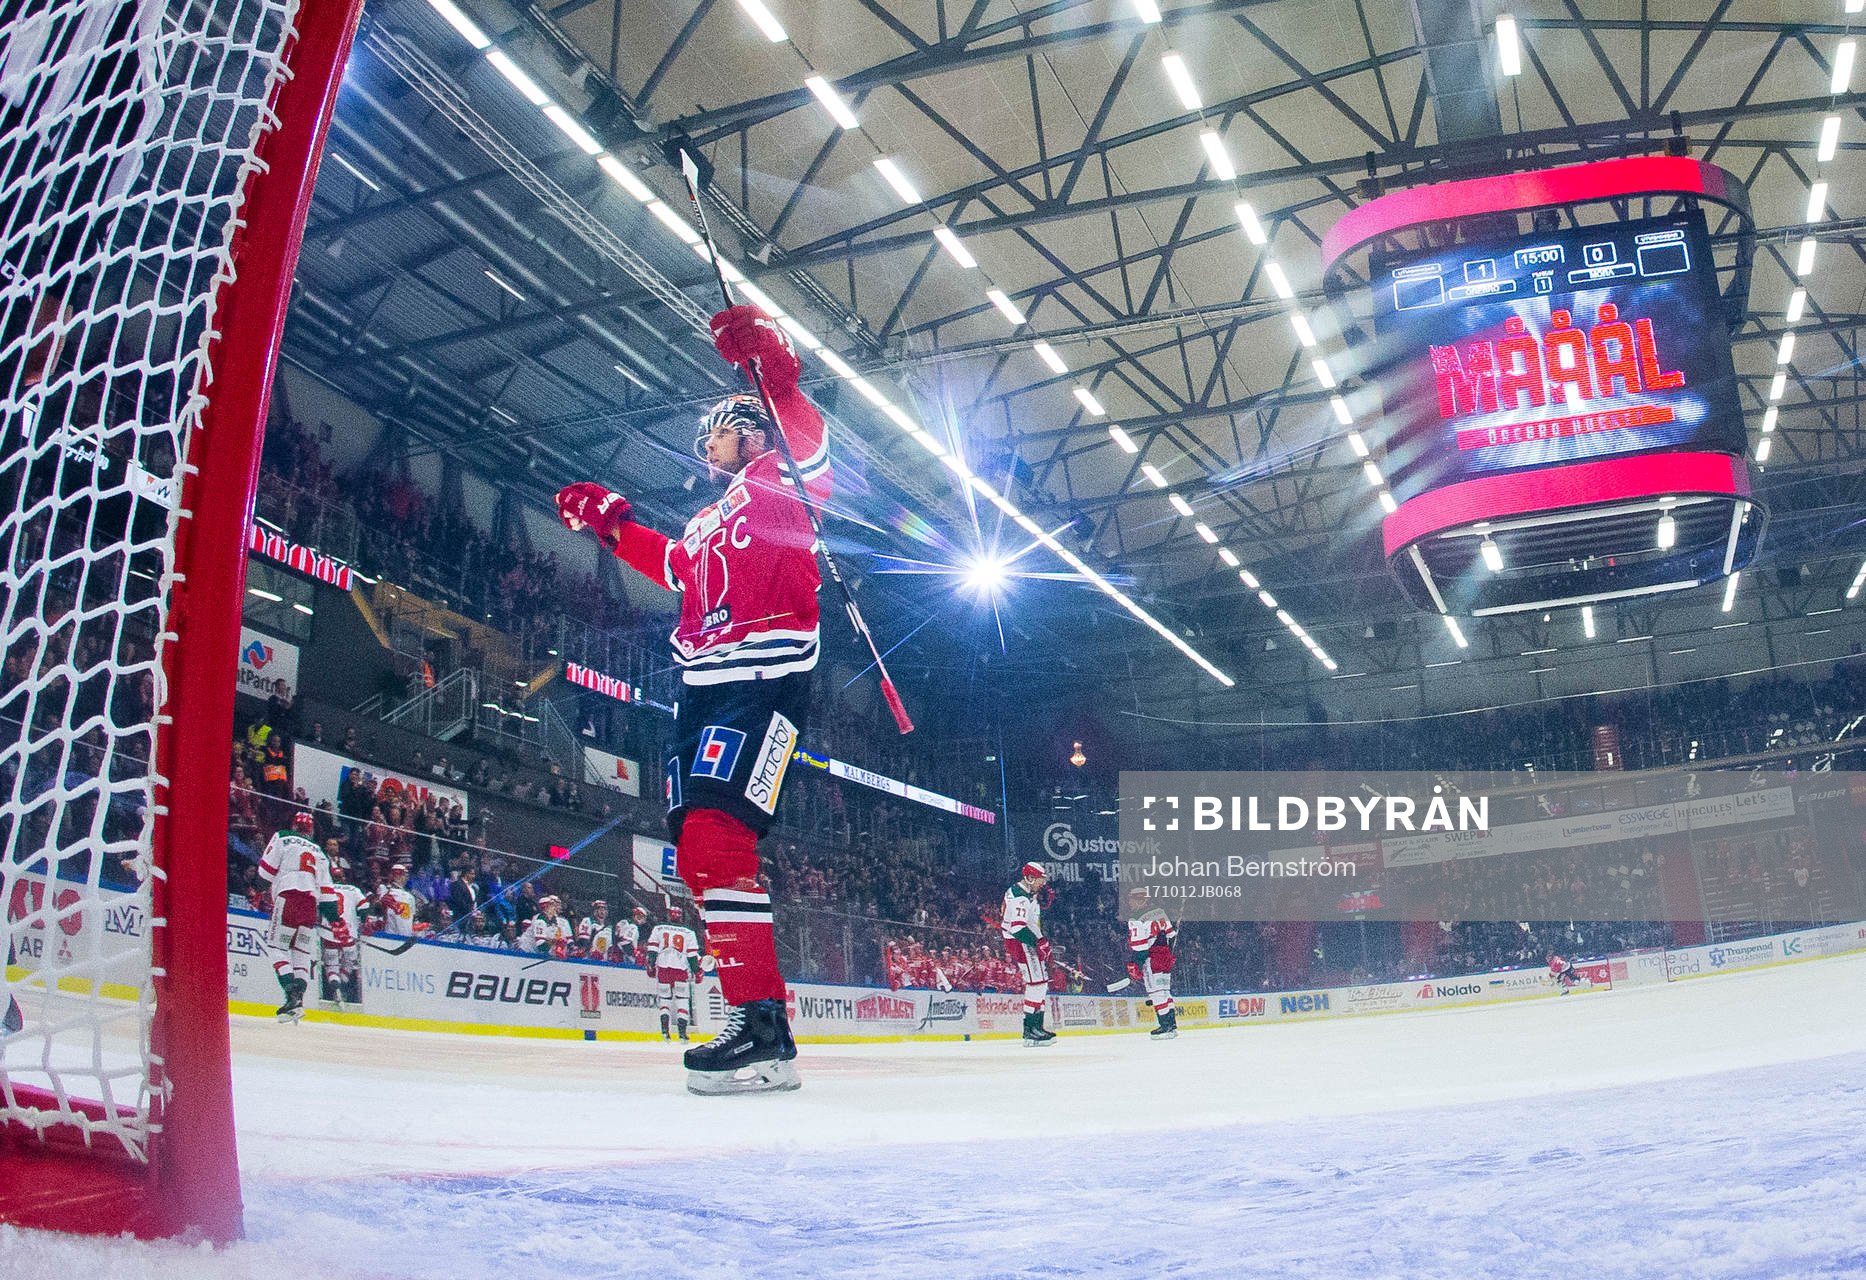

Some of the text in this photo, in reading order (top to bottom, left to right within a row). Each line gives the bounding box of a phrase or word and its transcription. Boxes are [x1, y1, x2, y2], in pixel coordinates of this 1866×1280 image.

[1520, 250, 1559, 265] 15:00
[1591, 247, 1604, 262] 0
[1478, 263, 1487, 278] 1
[1539, 279, 1547, 290] 1
[1429, 303, 1686, 419] MÅÅÅL
[731, 515, 752, 550] C
[750, 720, 789, 804] Structor
[843, 764, 891, 791] MALMBERGS
[1618, 807, 1671, 825] ESSWEGE
[1677, 802, 1732, 819] HERCULES
[1043, 822, 1162, 861] Gustavsvik
[662, 931, 685, 953] 19
[232, 963, 248, 977] AB
[364, 967, 436, 994] WELINS
[1437, 984, 1482, 998] Nolato
[799, 995, 853, 1020] WÜRTH
[1218, 997, 1266, 1017] ELON
